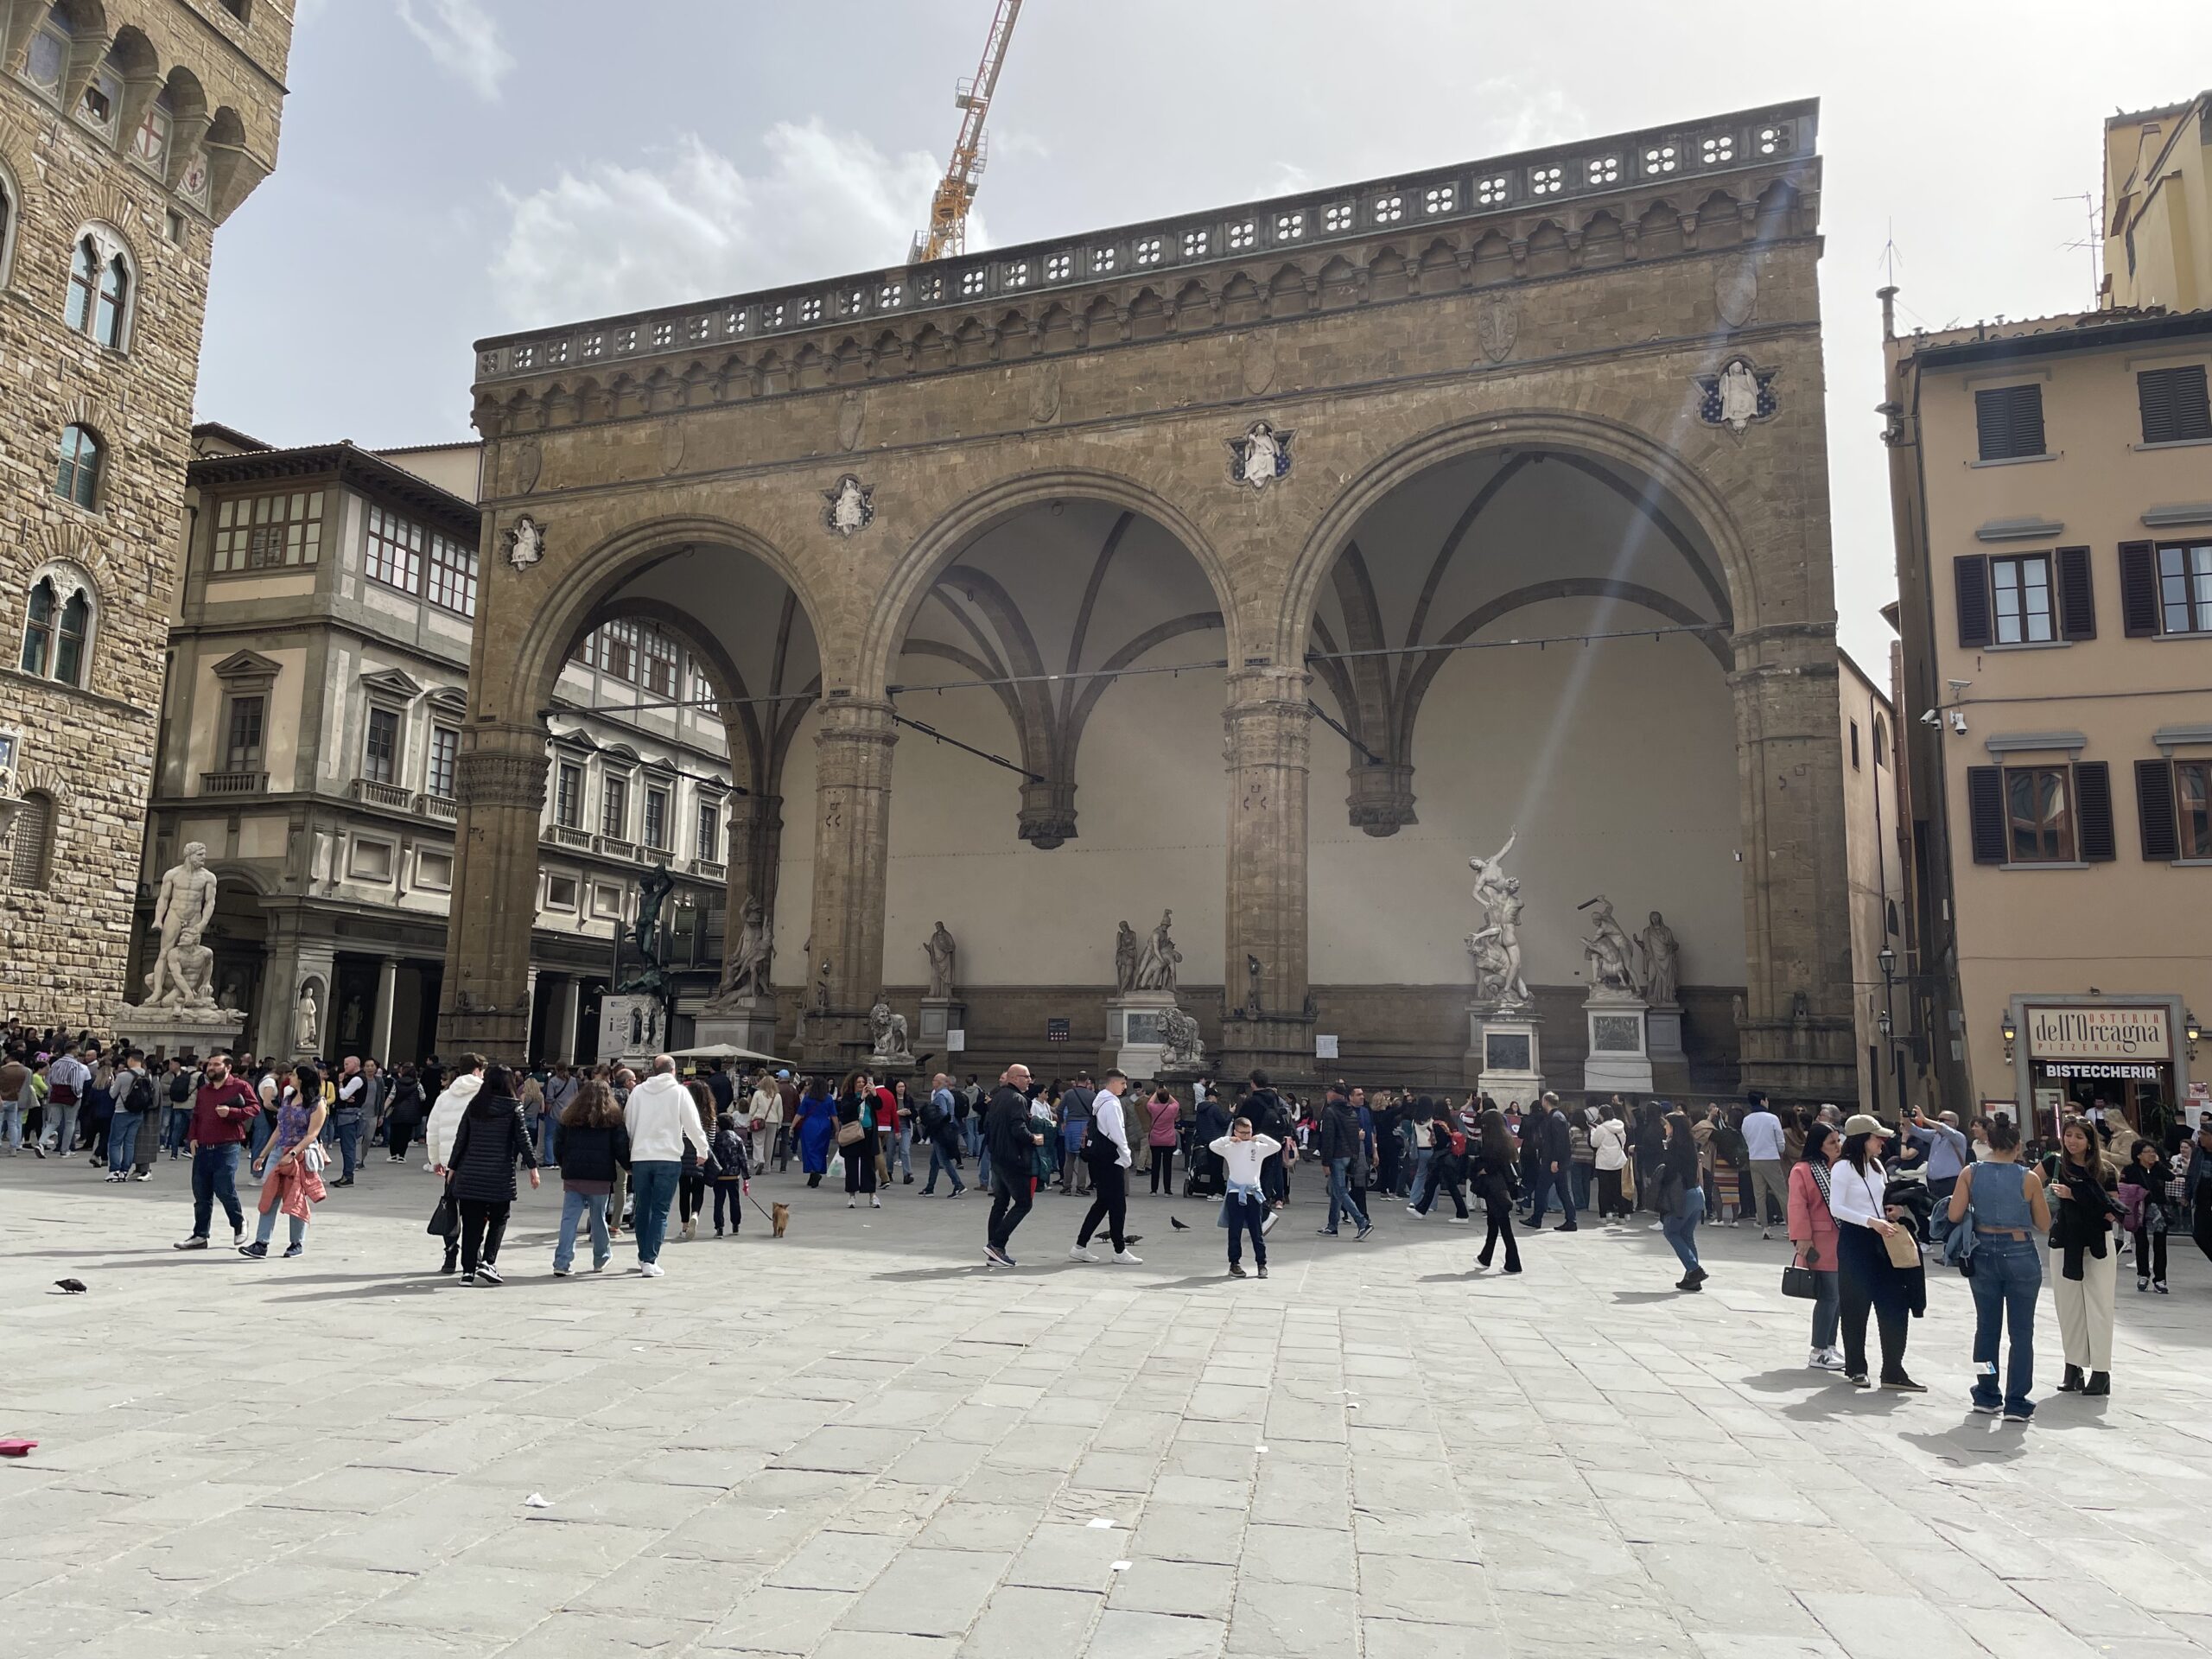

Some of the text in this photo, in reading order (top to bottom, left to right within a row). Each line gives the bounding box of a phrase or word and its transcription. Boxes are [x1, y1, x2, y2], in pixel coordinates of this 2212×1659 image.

[2088, 1014, 2159, 1024] OSTERIA
[2036, 1014, 2160, 1053] dell'Orcagna
[2038, 1043, 2120, 1052] PIZZERIA
[2046, 1065, 2157, 1079] BISTECCHERIA
